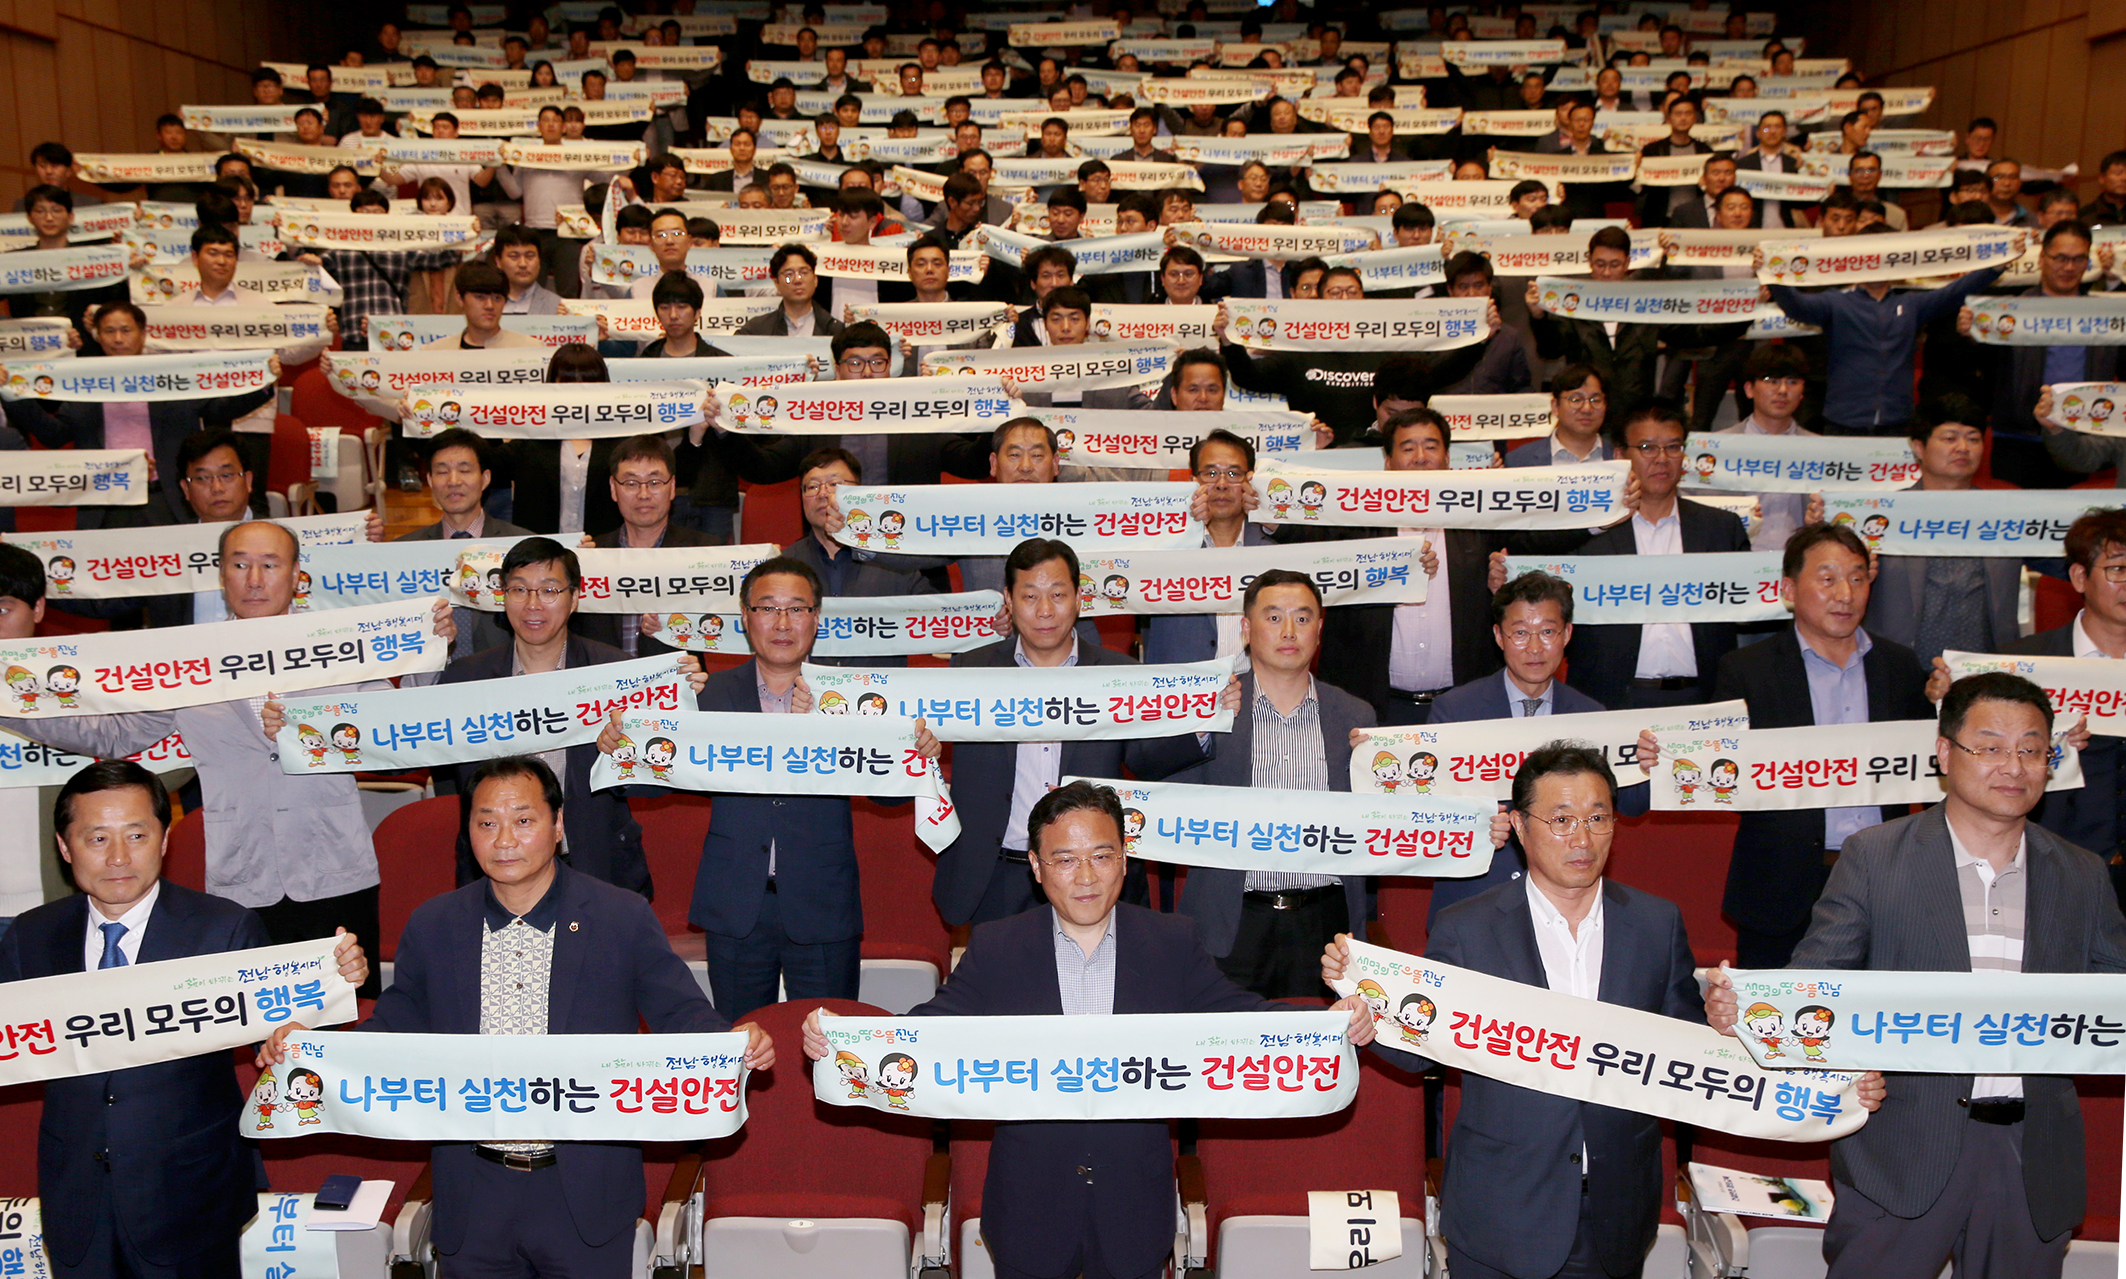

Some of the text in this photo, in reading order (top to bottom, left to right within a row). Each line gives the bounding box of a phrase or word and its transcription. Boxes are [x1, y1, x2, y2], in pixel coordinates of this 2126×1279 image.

[1423, 194, 1465, 206] 건설안전
[325, 228, 466, 241] 건설안전 우리 모두의 행복
[739, 226, 800, 237] 우리 모두의
[1218, 236, 1340, 251] 건설안전 우리 모두의
[1686, 246, 1733, 257] 건설안전
[823, 257, 903, 273] 건설안전 우리
[1497, 251, 1579, 268] 건설안전 우리
[1815, 242, 2008, 274] 건설안전 우리 모두의 행복
[4, 263, 124, 283] 실천하는 건설안전
[1367, 264, 1403, 279] 나부터
[1586, 296, 1756, 313] 나부터 실천하는 건설안전
[147, 323, 320, 338] 건설안전 우리 모두의 행복
[885, 318, 977, 335] 건설안전 우리
[1118, 321, 1205, 337] 건설안전 우리
[1285, 319, 1477, 340] 건설안전 우리 모두의 행복
[2023, 318, 2072, 333] 나부터
[30, 335, 62, 350] 행복
[459, 369, 492, 387] 우리
[496, 368, 545, 384] 모두의
[1050, 355, 1167, 379] 우리 모두의 행복
[62, 369, 264, 392] 나부터 실천하는 건설안전
[469, 402, 697, 426] 건설안전 우리 모두의 행복
[786, 399, 1012, 421] 건설안전 우리 모두의 행복
[1475, 414, 1505, 429] 우리
[1083, 433, 1301, 455] 건설안전 행복
[1725, 458, 1863, 480] 나부터 실천하는
[28, 473, 131, 492] 모두의 행복
[1336, 486, 1614, 513] 건설안전 우리 모두의 행복
[915, 511, 1188, 537] 나부터 실천하는 건설안전
[1899, 518, 2068, 540] 나부터 실천하는
[87, 553, 182, 579] 건설안전
[322, 569, 389, 594] 나부터
[617, 574, 735, 598] 우리 모두의
[1138, 565, 1410, 602] 건설안전 행복
[1583, 581, 1750, 607] 나부터 실천하는
[905, 612, 995, 638] 건설안전
[94, 630, 425, 693] 건설안전 우리 모두의 행복
[900, 692, 1217, 727] 나부터 실천하는 건설안전
[373, 718, 453, 751] 나부터
[461, 707, 569, 744] 실천하는
[690, 742, 893, 776] 나부터 실천하는
[1751, 755, 1917, 789] 건설안전 우리
[1158, 817, 1474, 858] 나부터 실천하는 건설안전
[65, 979, 326, 1048] 우리 모두의 행복
[1852, 1009, 2126, 1048] 나부터 실천하는
[934, 1055, 1340, 1094] 나부터 실천하는 건설안전
[1449, 1011, 1581, 1070] 건설안전
[1587, 1041, 1656, 1086] 우리
[1659, 1062, 1766, 1111] 모두의
[1775, 1081, 1842, 1125] 행복
[340, 1075, 741, 1115] 나부터 실천하는 건설안전
